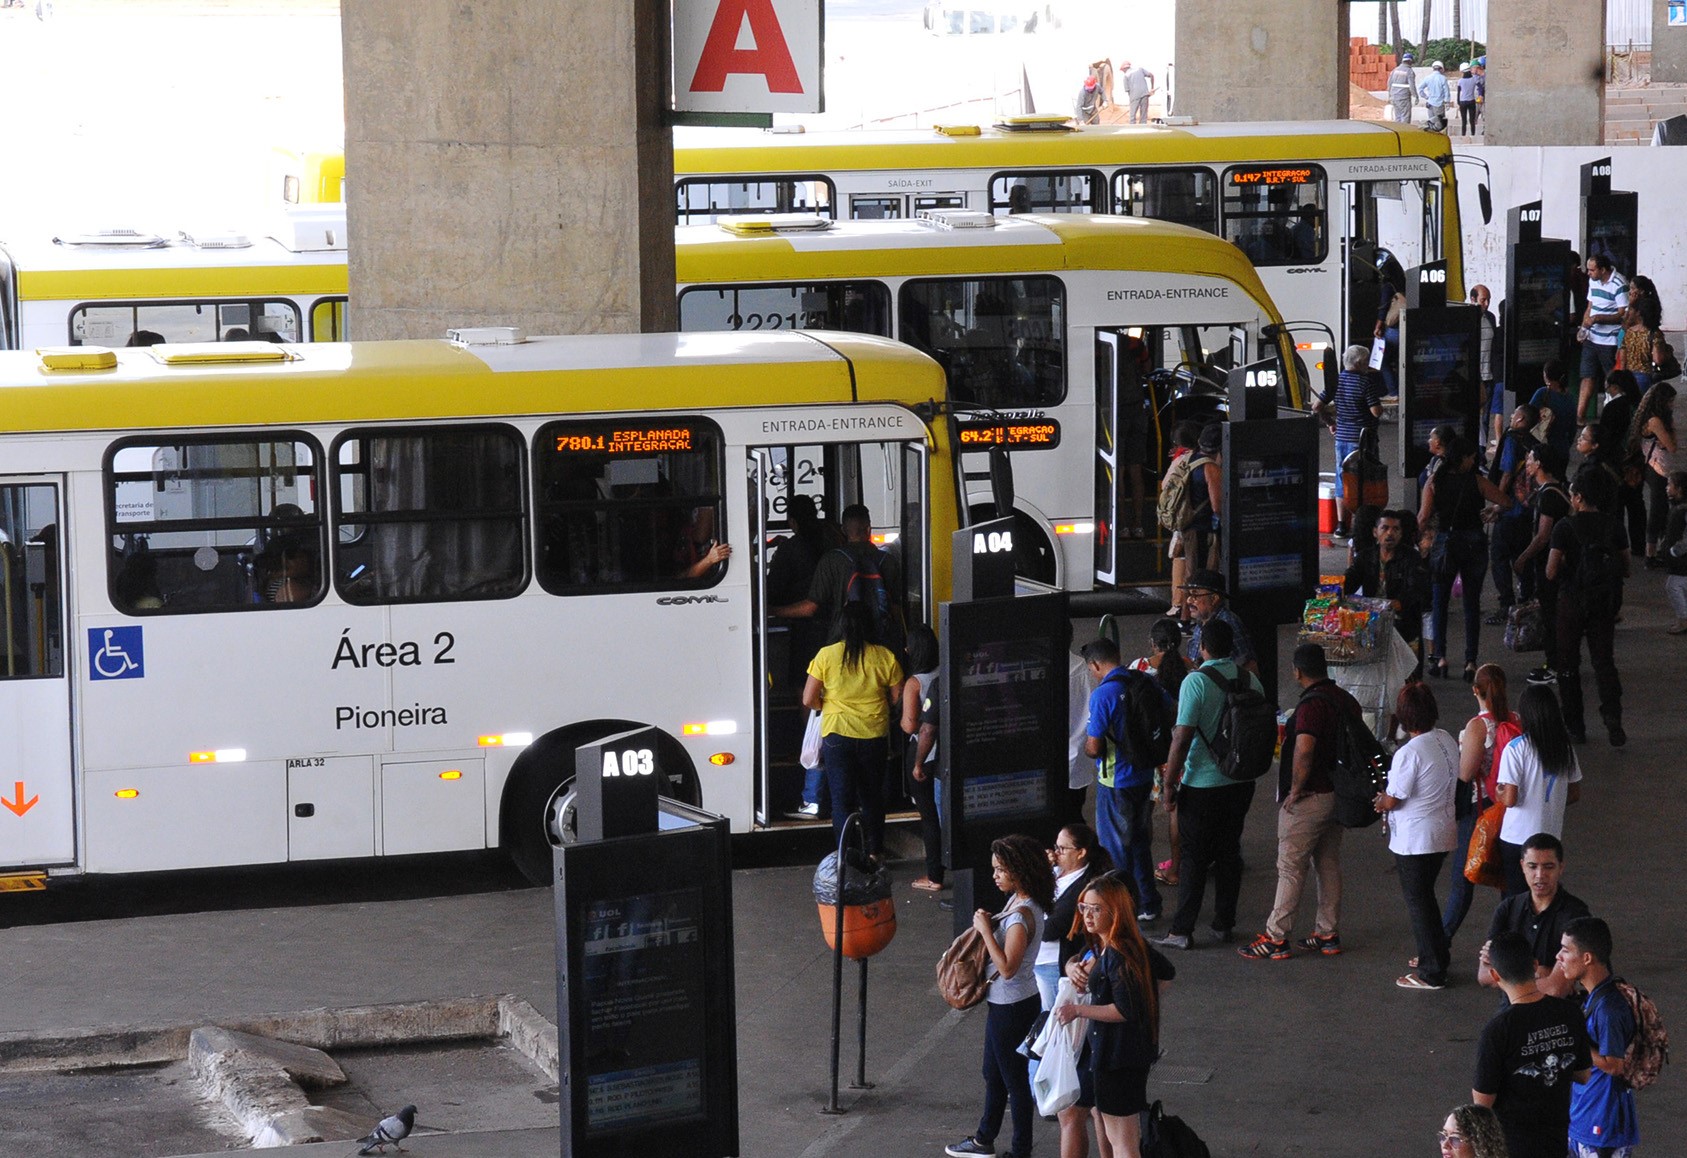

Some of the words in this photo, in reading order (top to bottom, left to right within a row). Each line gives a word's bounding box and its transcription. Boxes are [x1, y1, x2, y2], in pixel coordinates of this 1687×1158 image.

[689, 0, 804, 94] A
[1348, 163, 1429, 173] ENTRADA-ENTRANCE
[1592, 166, 1599, 176] A
[1599, 165, 1611, 176] 08
[888, 178, 933, 188] SAÍDA-EXIT
[1520, 210, 1528, 222] A
[1529, 209, 1540, 222] 07
[1420, 271, 1429, 283] A
[1430, 270, 1445, 283] 06
[1107, 288, 1229, 301] ENTRADA-ENTRANCE
[1245, 371, 1256, 387] A
[1257, 370, 1277, 387] 05
[762, 416, 904, 433] ENTRADA-ENTRANCE
[557, 436, 605, 451] 780.1
[613, 430, 690, 442] ESPLANADA
[1030, 434, 1049, 443] SUL
[974, 533, 987, 554] A
[988, 532, 1013, 553] 04
[331, 627, 421, 670] Área
[433, 631, 455, 665] 2
[335, 703, 448, 730] Pioneira
[289, 759, 312, 768] ARLA
[314, 758, 325, 766] 32
[602, 751, 622, 777] A
[623, 749, 654, 776] 03
[1527, 1024, 1568, 1046] AVENGED
[1521, 1036, 1575, 1056] SEVENFOLD
